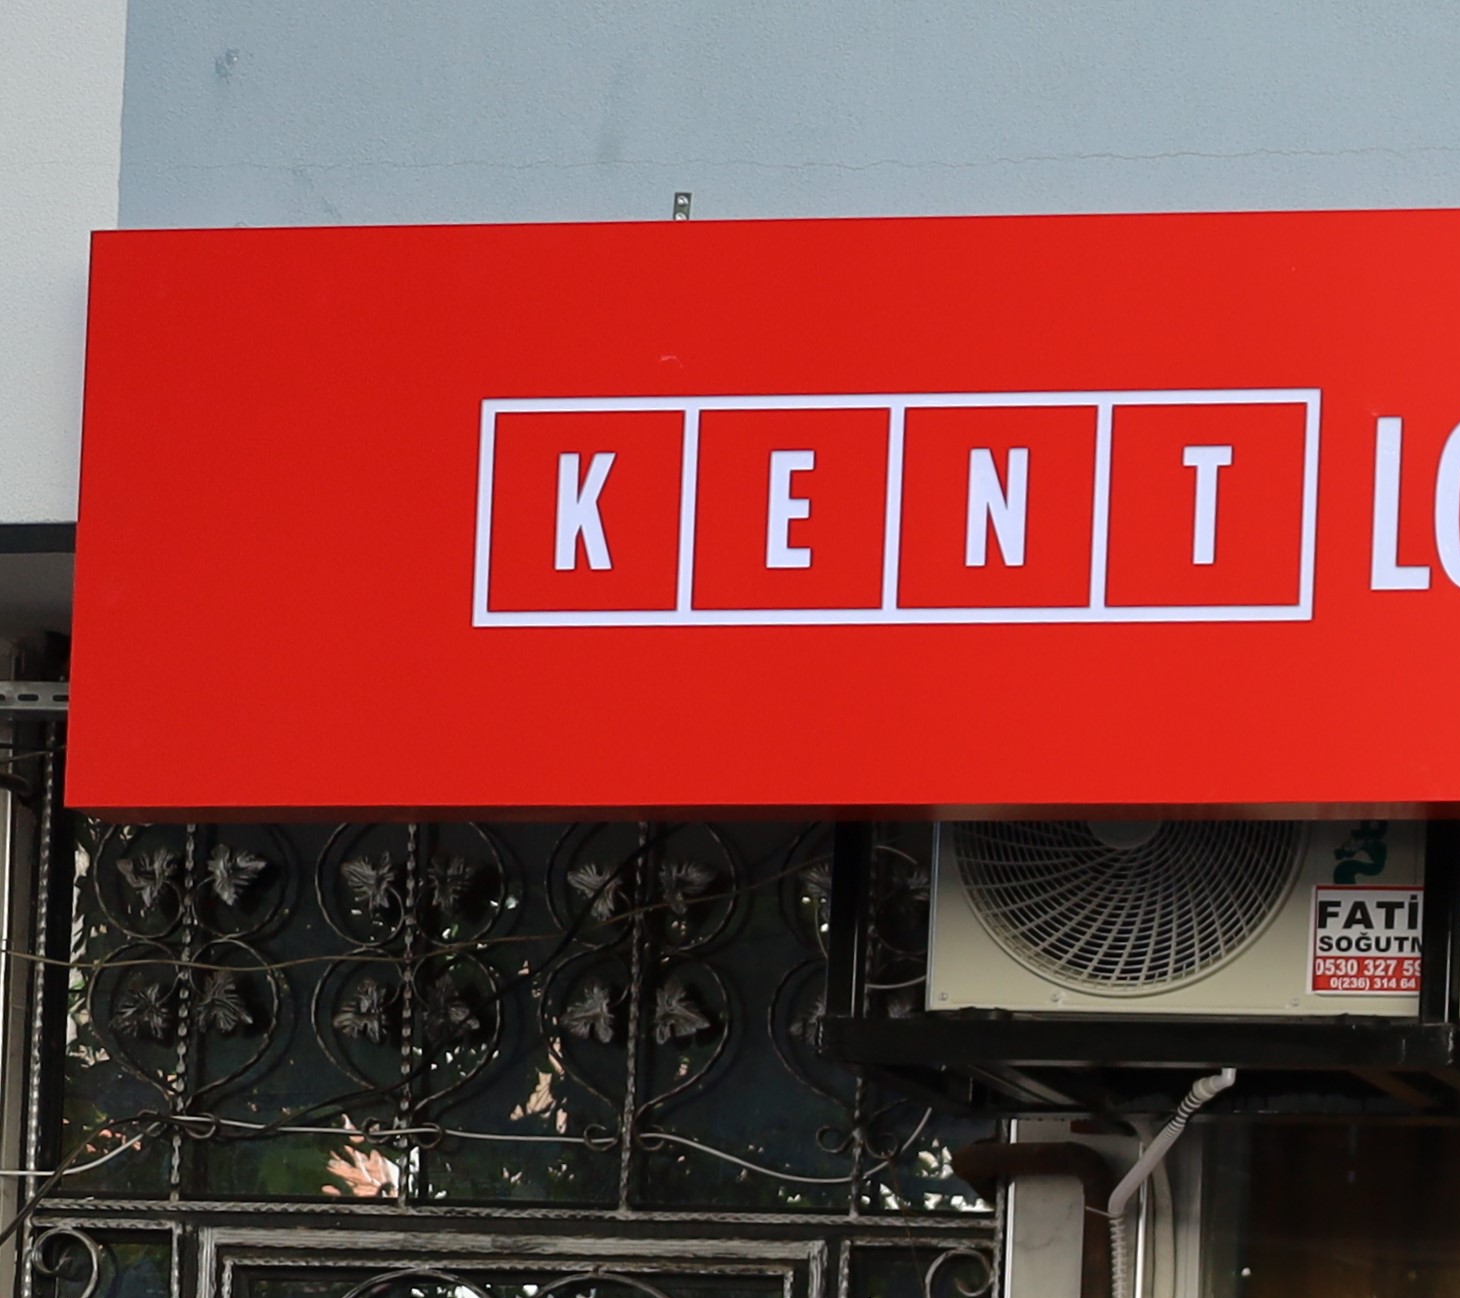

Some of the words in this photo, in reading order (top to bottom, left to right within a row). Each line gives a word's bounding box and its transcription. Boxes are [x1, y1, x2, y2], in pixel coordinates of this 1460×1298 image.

[552, 445, 1233, 572] KENT
[1317, 894, 1420, 930] FATİ
[1315, 958, 1358, 976] 0530
[1363, 959, 1397, 977] 327
[1373, 978, 1397, 989] 314
